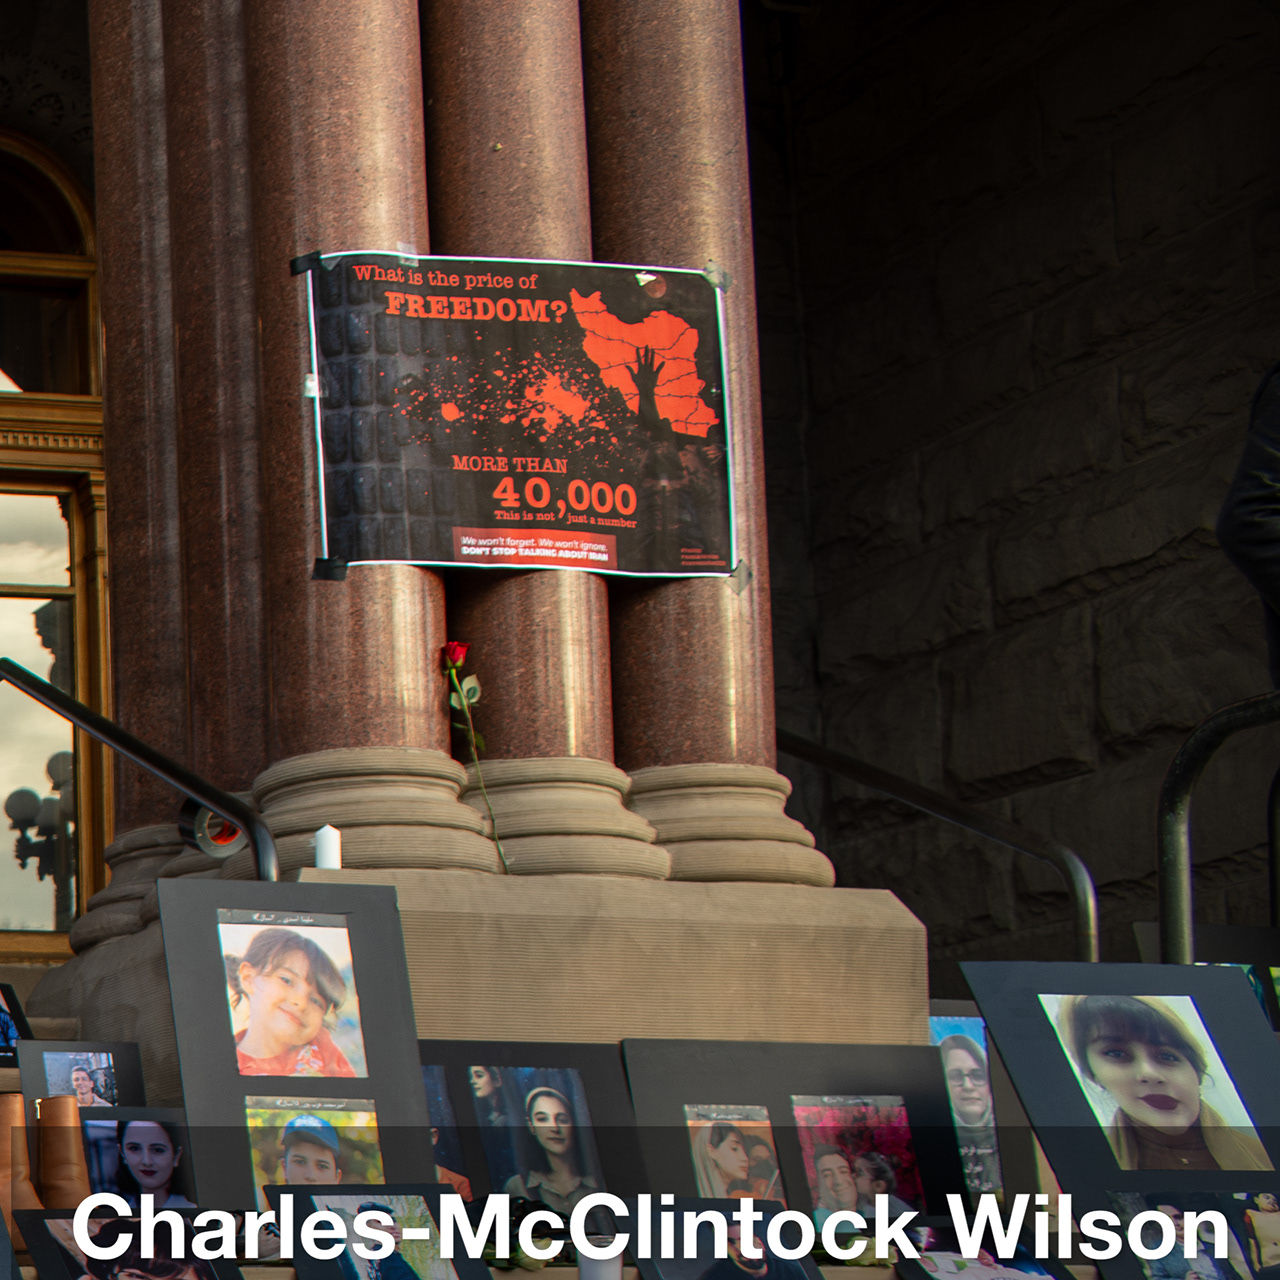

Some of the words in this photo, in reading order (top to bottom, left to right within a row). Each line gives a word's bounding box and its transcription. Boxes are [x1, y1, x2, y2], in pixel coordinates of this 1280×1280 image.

[352, 265, 405, 282] What
[408, 270, 423, 285] is
[428, 271, 459, 286] the
[464, 273, 514, 290] price
[519, 274, 538, 289] of
[384, 291, 568, 323] FREEDOM?
[452, 455, 508, 471] MORE
[513, 457, 568, 473] THAN
[492, 477, 637, 518] 40,000
[494, 510, 520, 520] This
[523, 511, 533, 520] is
[536, 511, 555, 521] not
[567, 513, 588, 524] just
[590, 516, 596, 524] a
[597, 517, 637, 528] number
